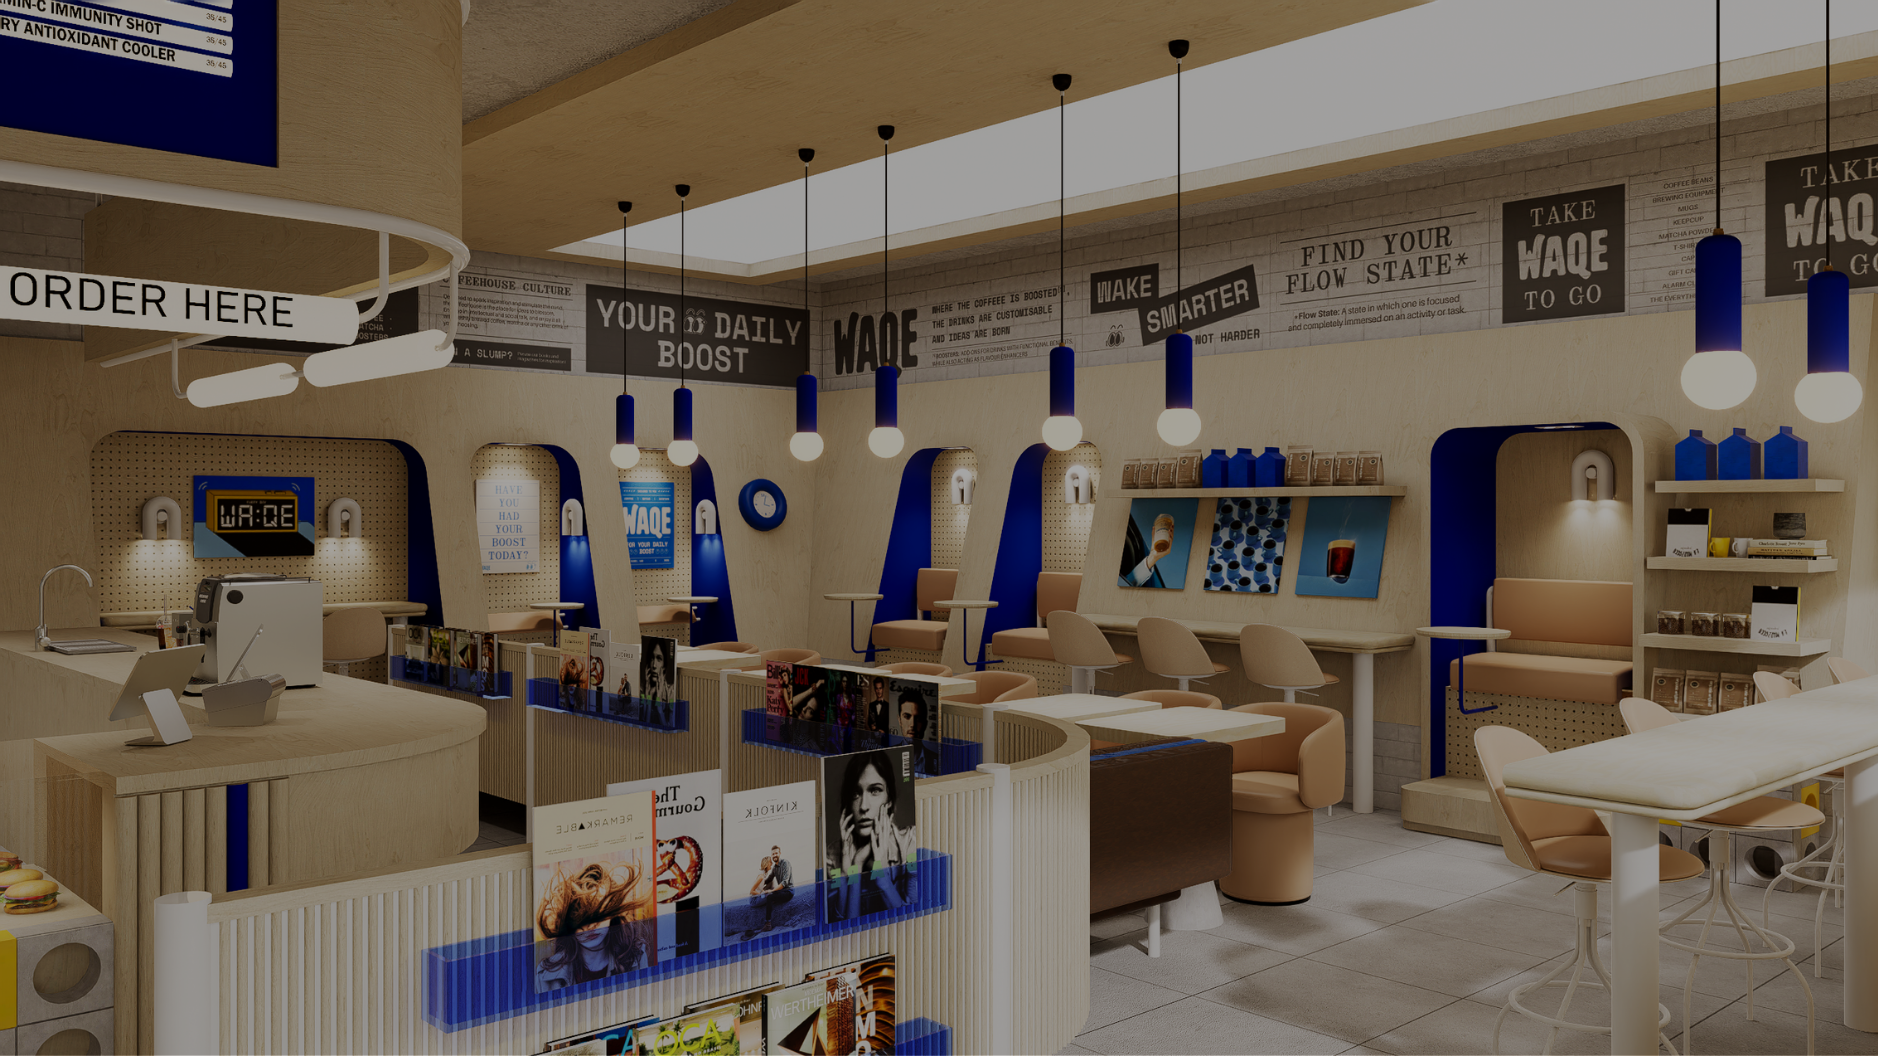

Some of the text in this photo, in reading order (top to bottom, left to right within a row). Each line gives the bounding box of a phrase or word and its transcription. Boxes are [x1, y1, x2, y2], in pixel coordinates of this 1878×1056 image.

[51, 1, 162, 36] IMMUNITY SHOT
[24, 21, 119, 51] ANTIOXIDANT
[122, 41, 176, 62] COOLER
[1663, 176, 1713, 190] COFFEE BEANS
[1800, 156, 1878, 189] TAKE
[1652, 187, 1725, 204] BREWING EQUIPMET
[1530, 199, 1596, 228] TAKE
[1677, 204, 1698, 212] MUGS
[1673, 216, 1704, 225] KEEPCUP
[1659, 230, 1687, 240] MATCHA
[1301, 226, 1453, 268] FIND YOUR
[1517, 228, 1609, 281] WAQE
[1285, 267, 1348, 295] FLOW
[1668, 269, 1683, 277] GIFT
[522, 282, 572, 296] CULTURE
[1097, 274, 1152, 304] WAKE
[1662, 281, 1686, 289] ALARM
[10, 272, 294, 328] ORDER HERE
[932, 305, 953, 315] WHERE
[957, 301, 971, 311] THE
[1010, 293, 1020, 303] IS
[1146, 278, 1250, 334] SMARTER
[1318, 308, 1340, 318] State:
[1348, 304, 1366, 314] state
[1367, 304, 1375, 312] in
[1376, 300, 1400, 311] which
[1402, 300, 1417, 309] one
[1418, 298, 1425, 307] is
[1427, 294, 1460, 306] focused
[1524, 284, 1602, 311] TO GO
[1650, 295, 1663, 303] THE
[596, 298, 802, 346] YOUR DAILY
[932, 305, 1053, 329] THE DRINKS ARE CUSTOMISABLE
[1288, 323, 1301, 332] and
[1303, 318, 1344, 331] completely
[1344, 315, 1382, 326] immersed
[1384, 314, 1394, 322] on
[1406, 308, 1436, 321] activity
[1448, 306, 1467, 316] task.
[834, 308, 918, 379] WAQE
[932, 326, 1011, 344] AND IDEAS ARE BORN
[1195, 328, 1260, 345] NOT HARDER
[464, 348, 471, 357] A
[476, 348, 513, 360] SLUMP?
[657, 339, 749, 374] BOOST
[495, 485, 523, 495] HAVE
[499, 498, 519, 508] YOU
[498, 511, 520, 521] HAD
[623, 504, 672, 539] WAQE
[495, 524, 523, 534] YOUR
[492, 537, 526, 547] BOOST
[488, 550, 529, 561] TODAY?
[794, 667, 810, 686] JCK
[770, 984, 855, 1021] WERTHEIMER
